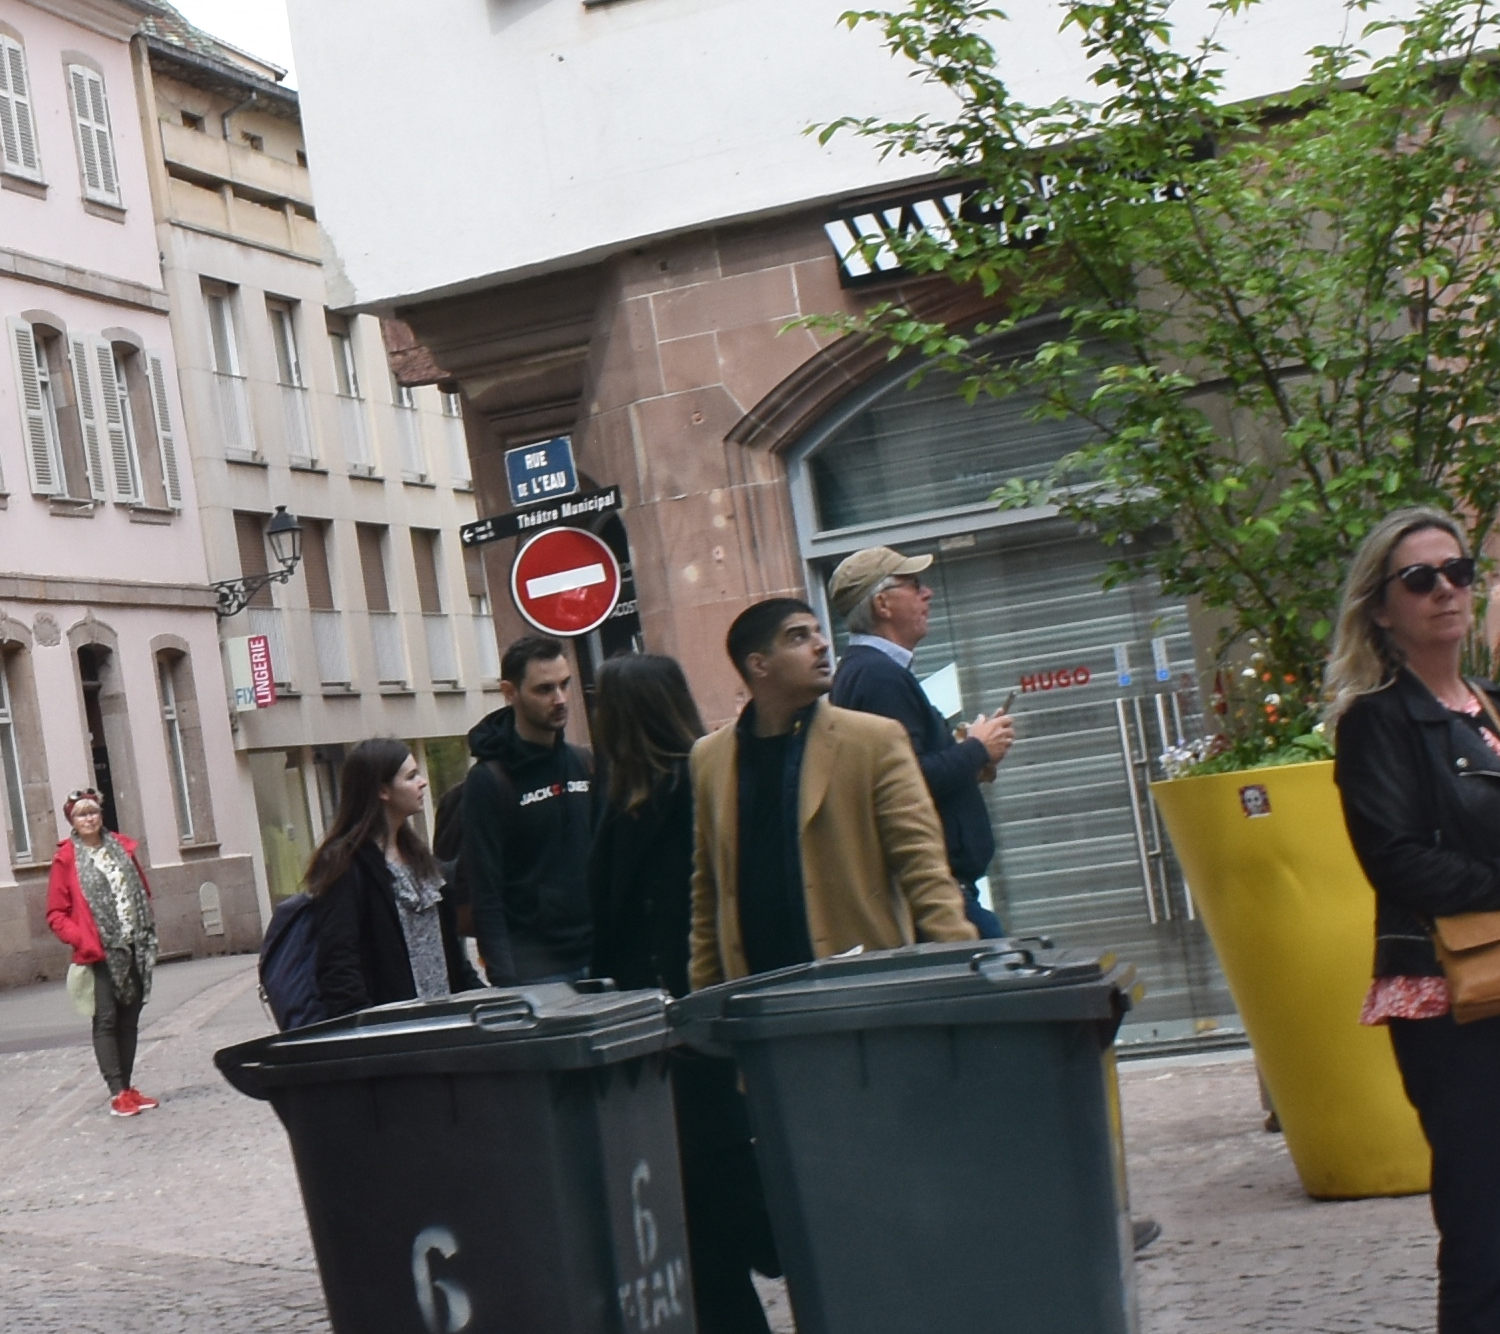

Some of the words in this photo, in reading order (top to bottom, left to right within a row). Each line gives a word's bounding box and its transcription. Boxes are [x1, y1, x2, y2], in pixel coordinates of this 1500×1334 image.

[525, 450, 548, 470] RUE
[517, 483, 529, 498] DE
[531, 471, 566, 494] L'EAU
[517, 509, 559, 529] Théâtre
[561, 490, 616, 518] Municipal
[250, 638, 272, 704] LINGERIE
[1021, 665, 1091, 693] HUGO
[235, 687, 256, 706] FIX
[631, 1162, 658, 1267] 6
[411, 1225, 472, 1334] 6
